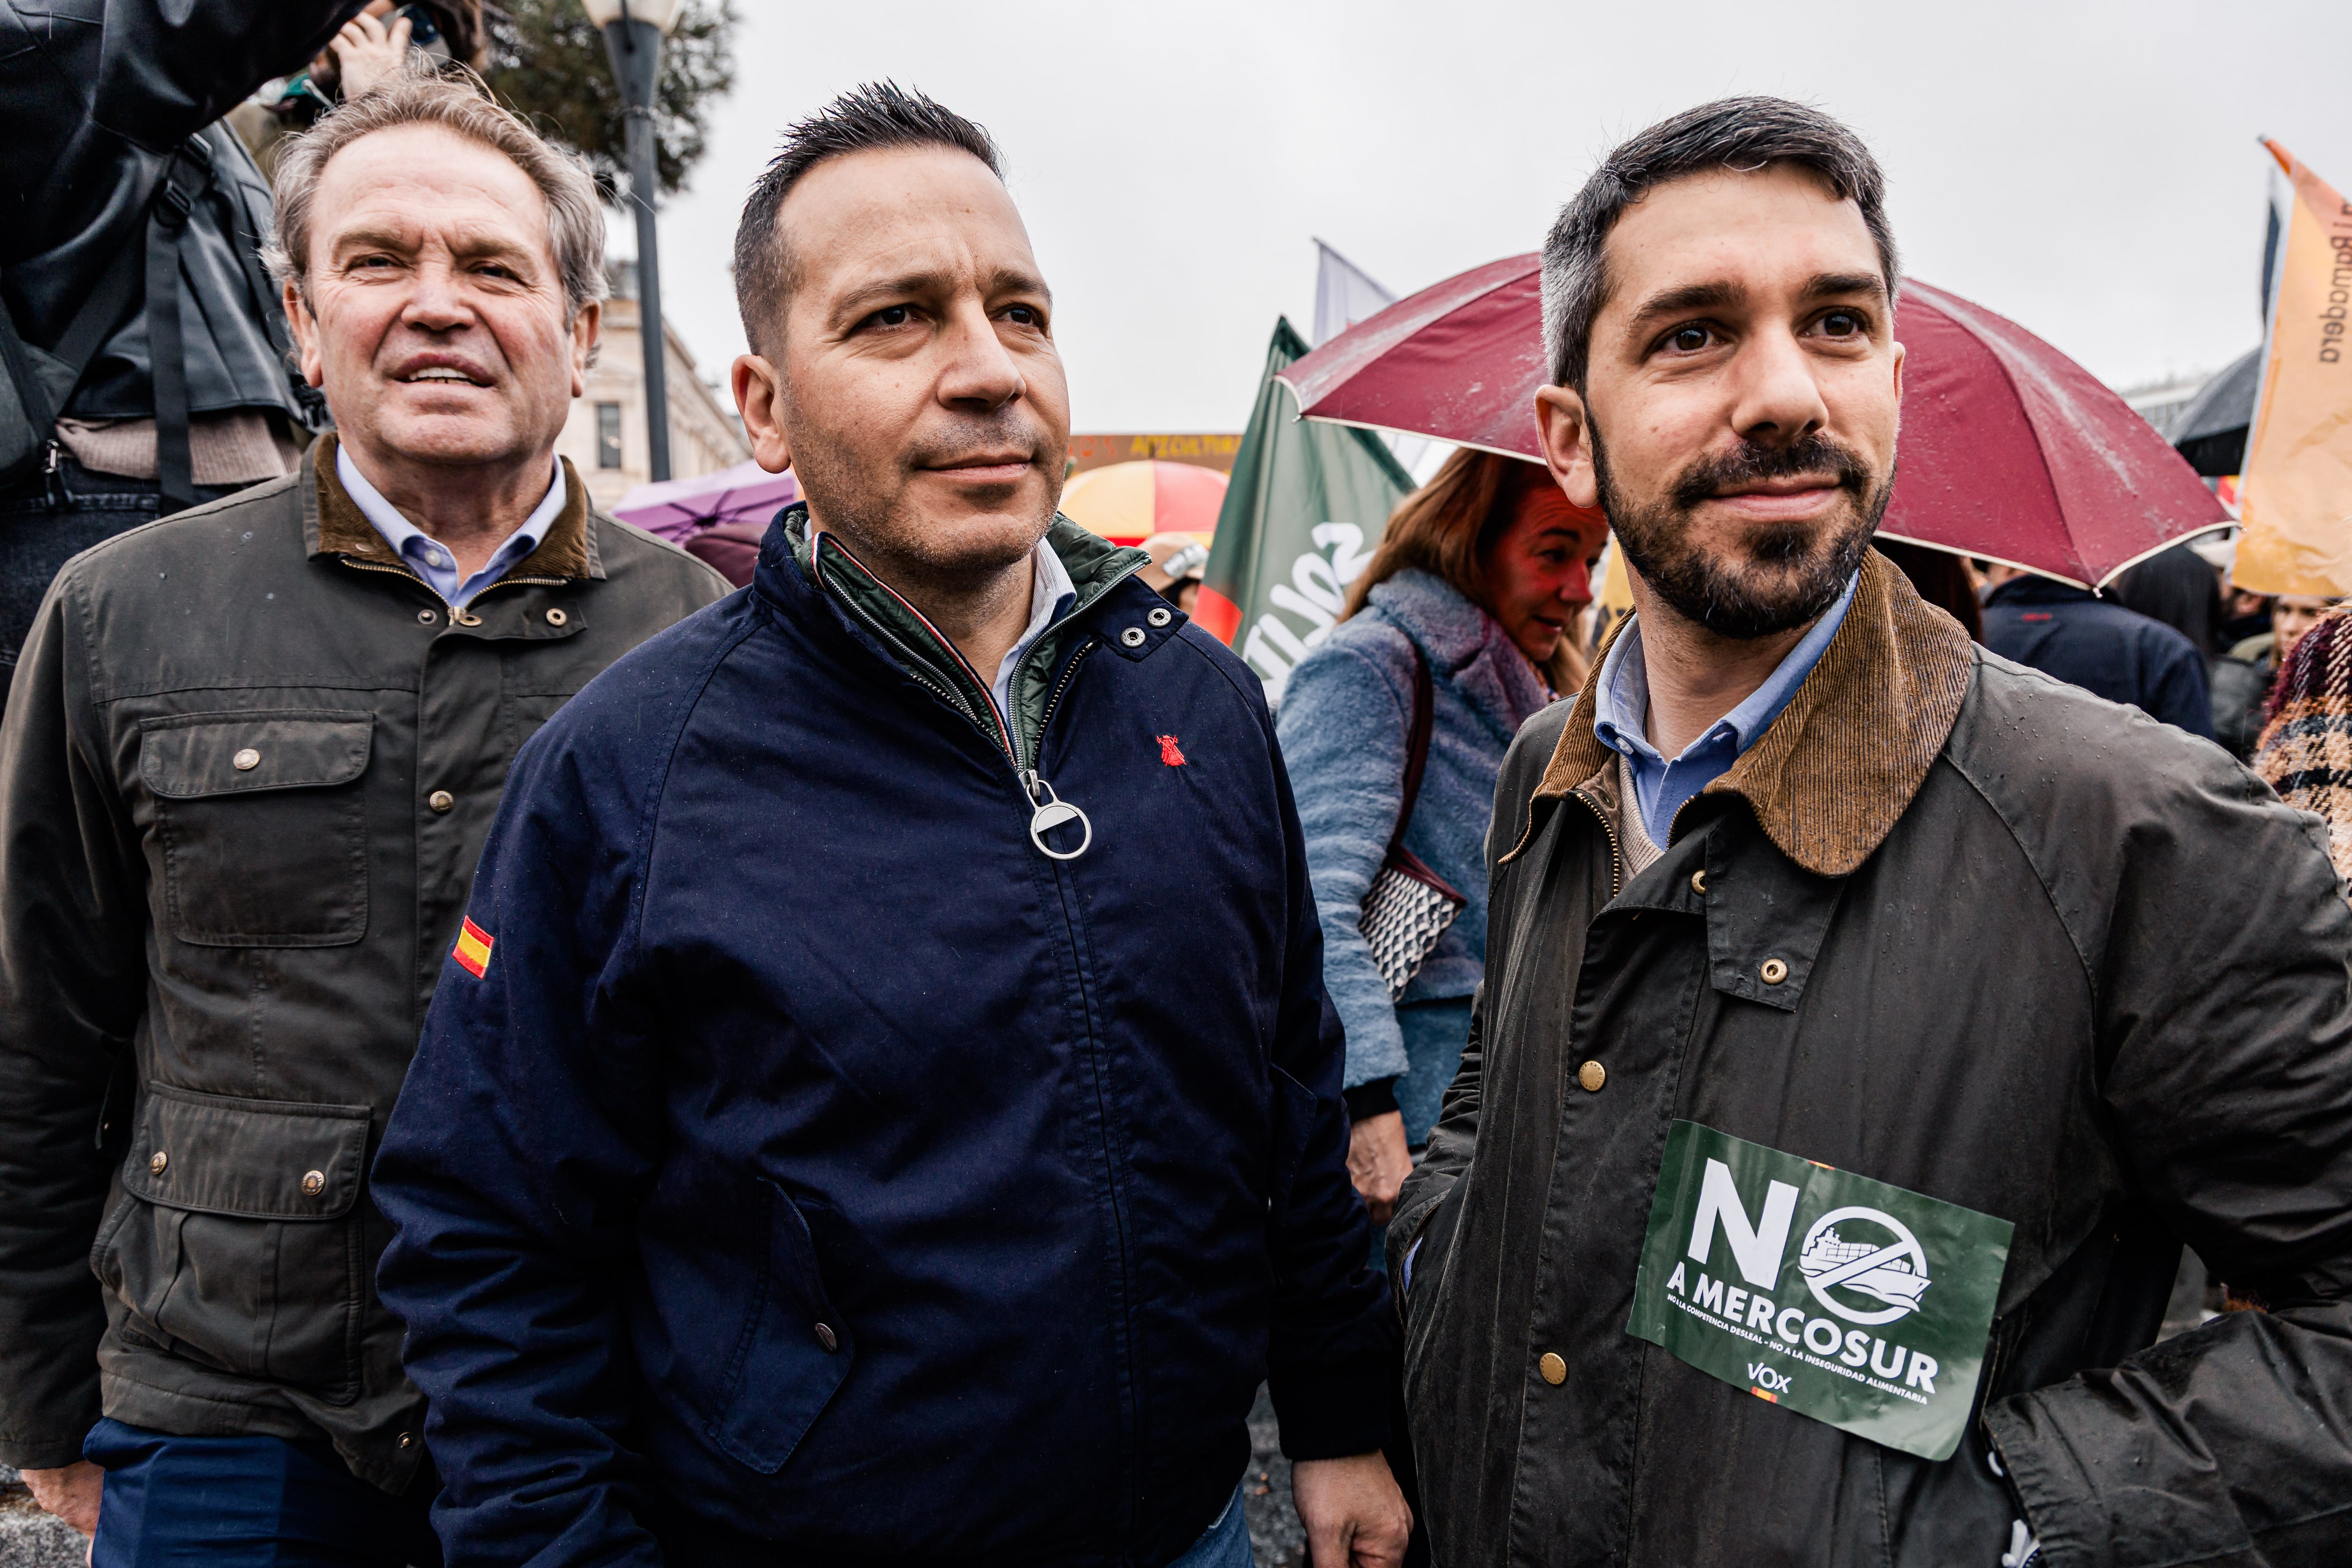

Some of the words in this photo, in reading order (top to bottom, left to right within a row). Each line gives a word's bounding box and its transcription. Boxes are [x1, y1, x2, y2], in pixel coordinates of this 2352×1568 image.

[1666, 1261, 1685, 1296] A
[1692, 1273, 1939, 1394] MERCOSUR
[1667, 1293, 1676, 1303] NO
[1678, 1301, 1686, 1310] LA
[1686, 1305, 1729, 1331] COMPETENCIA
[1730, 1325, 1763, 1344] DESLEAL
[1769, 1341, 1783, 1352] NO
[1792, 1349, 1803, 1360] LA
[1804, 1353, 1866, 1382] INSEGURIDAD
[1866, 1377, 1928, 1405] ALIMENTARIA
[1748, 1362, 1792, 1394] VOX
